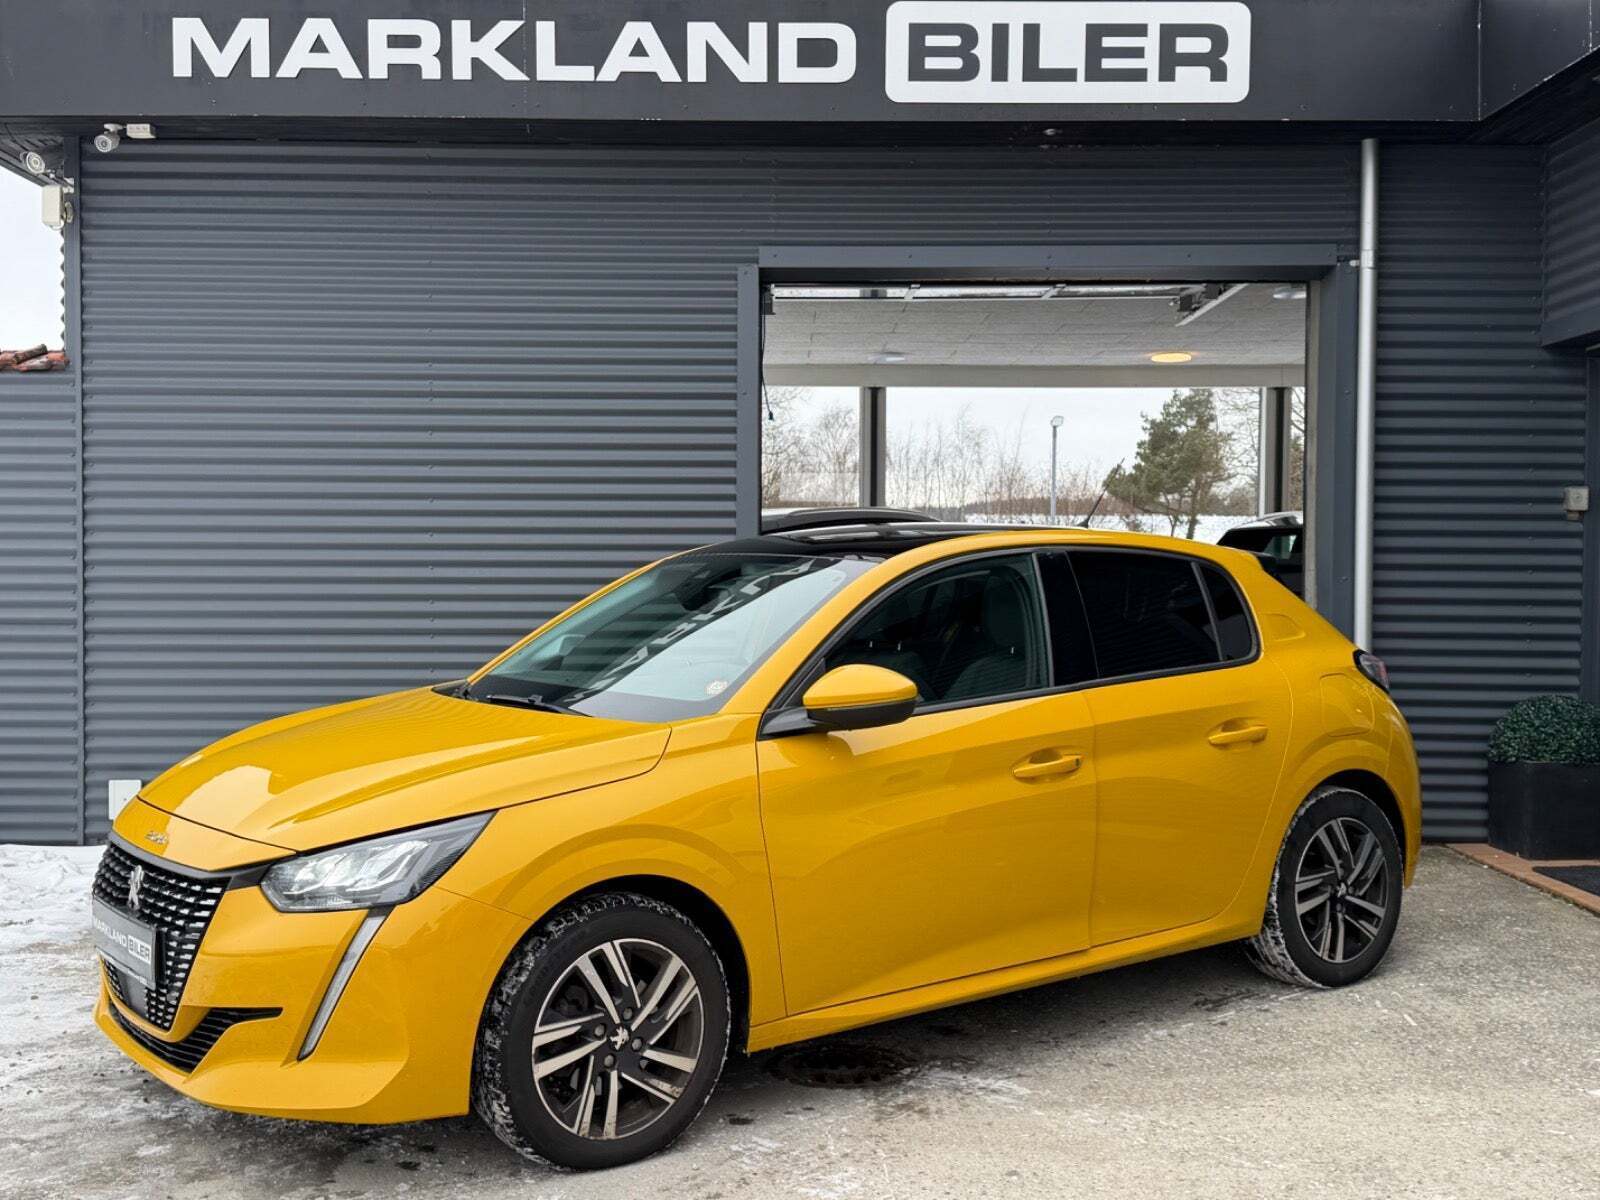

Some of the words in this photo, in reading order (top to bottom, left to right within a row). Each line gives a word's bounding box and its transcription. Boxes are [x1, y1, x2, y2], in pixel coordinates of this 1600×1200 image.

[171, 17, 856, 83] MARKLAND
[909, 23, 1228, 82] BILER
[129, 938, 150, 961] BILER
